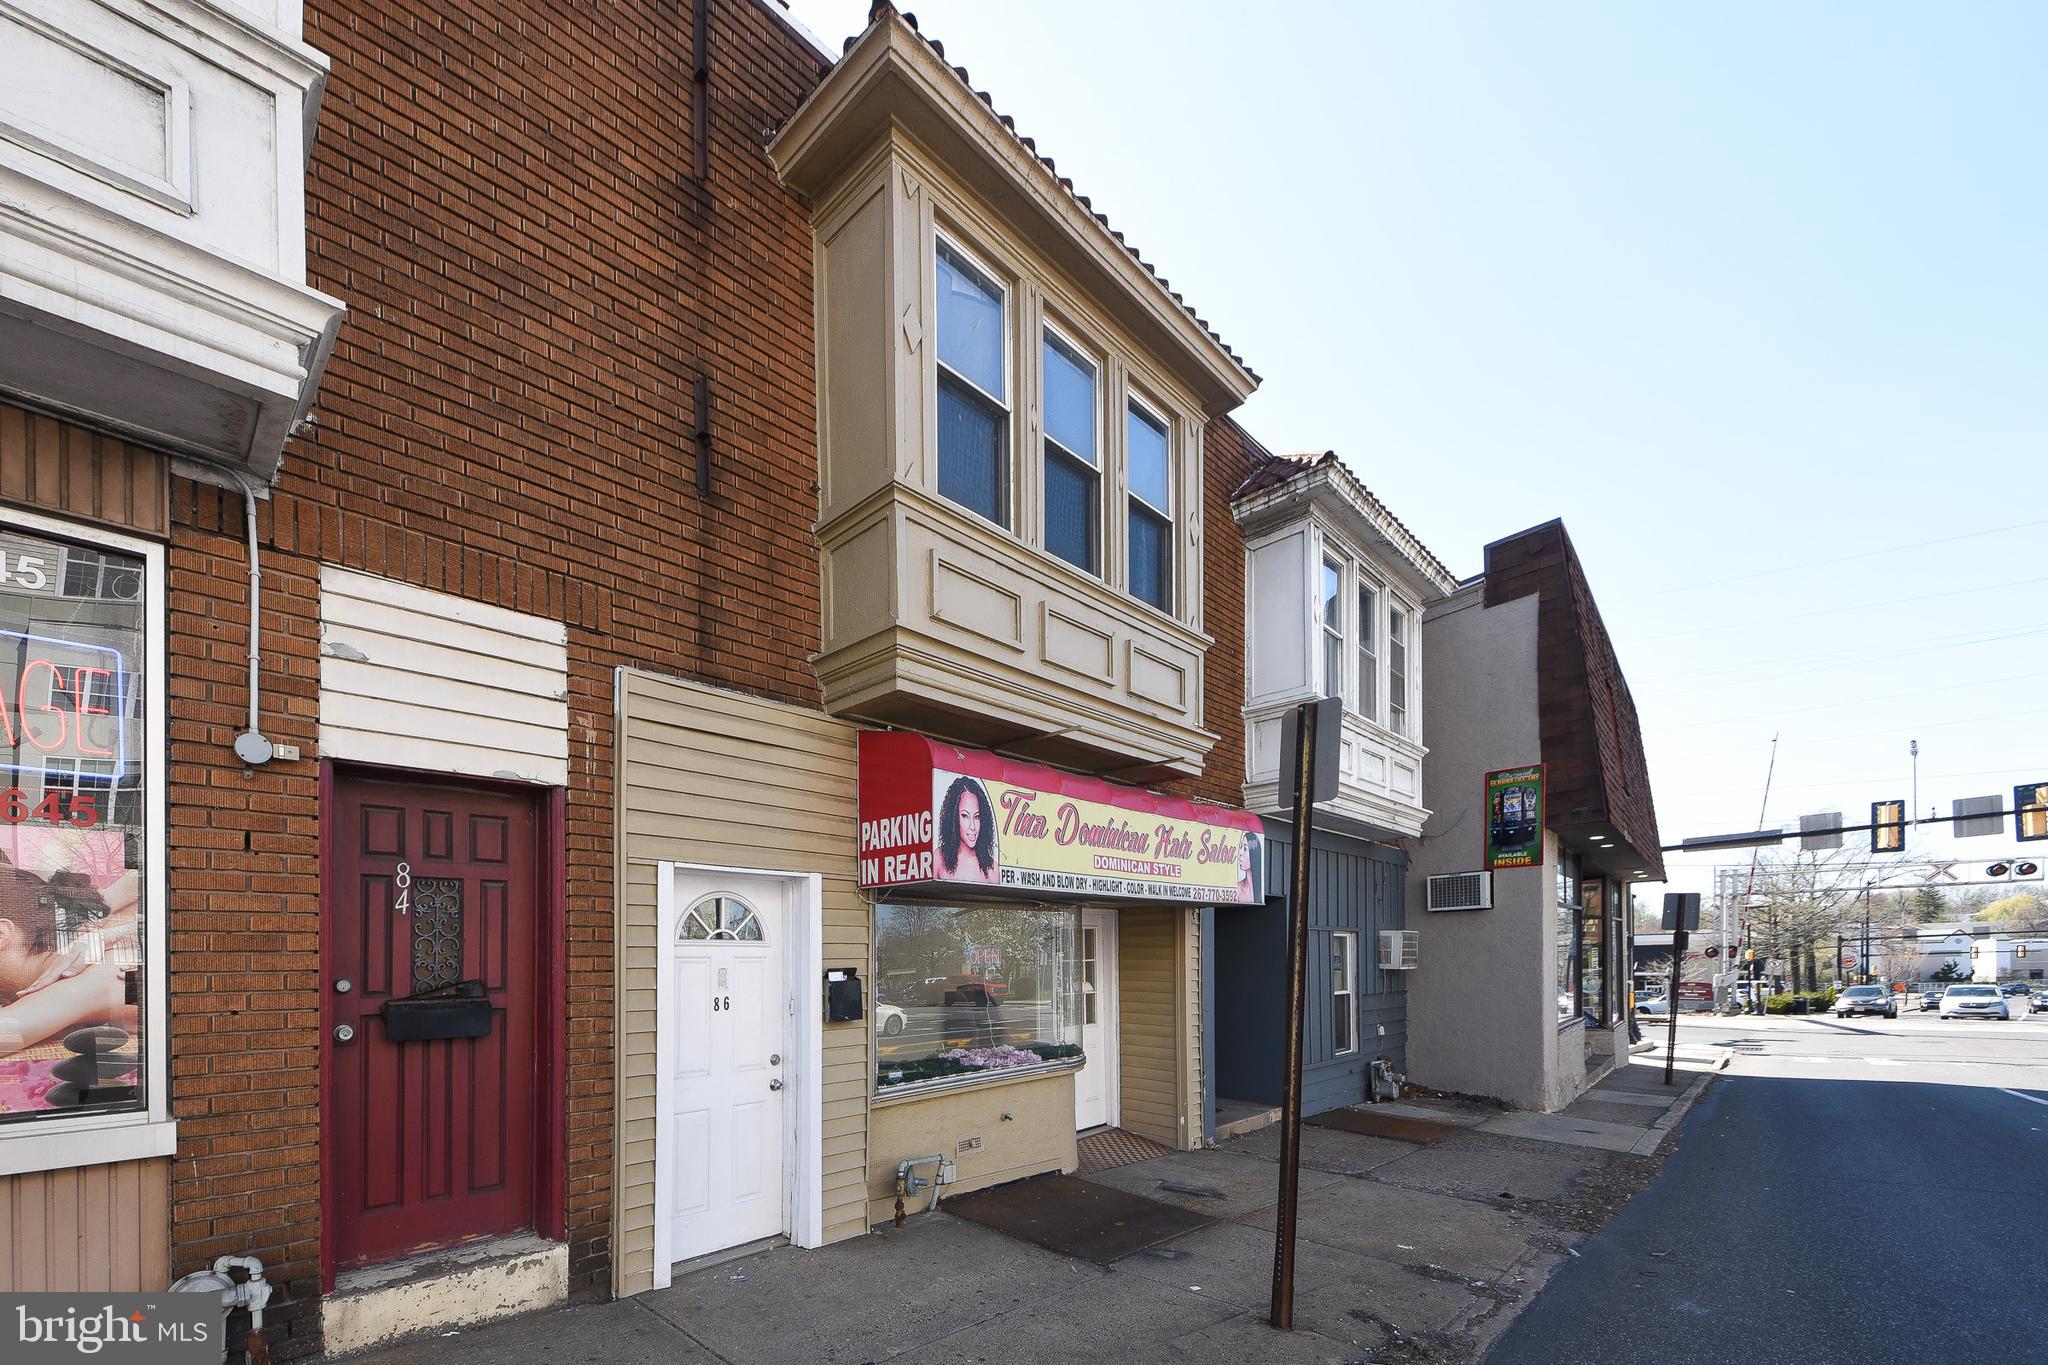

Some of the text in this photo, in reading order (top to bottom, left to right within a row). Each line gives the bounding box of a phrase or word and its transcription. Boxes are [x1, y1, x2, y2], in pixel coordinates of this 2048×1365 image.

[0, 789, 98, 828] 645
[862, 810, 932, 852] PARKING
[1000, 789, 1237, 865] Tina Dominican Hair Salon
[862, 851, 933, 885] IN REAR
[1094, 855, 1181, 877] DOMINICAN STYLE
[1493, 857, 1532, 866] INSIDE
[395, 862, 411, 915] 84
[1001, 869, 1238, 902] PER WASH AND BLOW DRY HIGHLIGHT COLOR WALK IN WELCOME 267-770-3592
[970, 949, 1001, 964] OPEN
[713, 996, 730, 1012] 86
